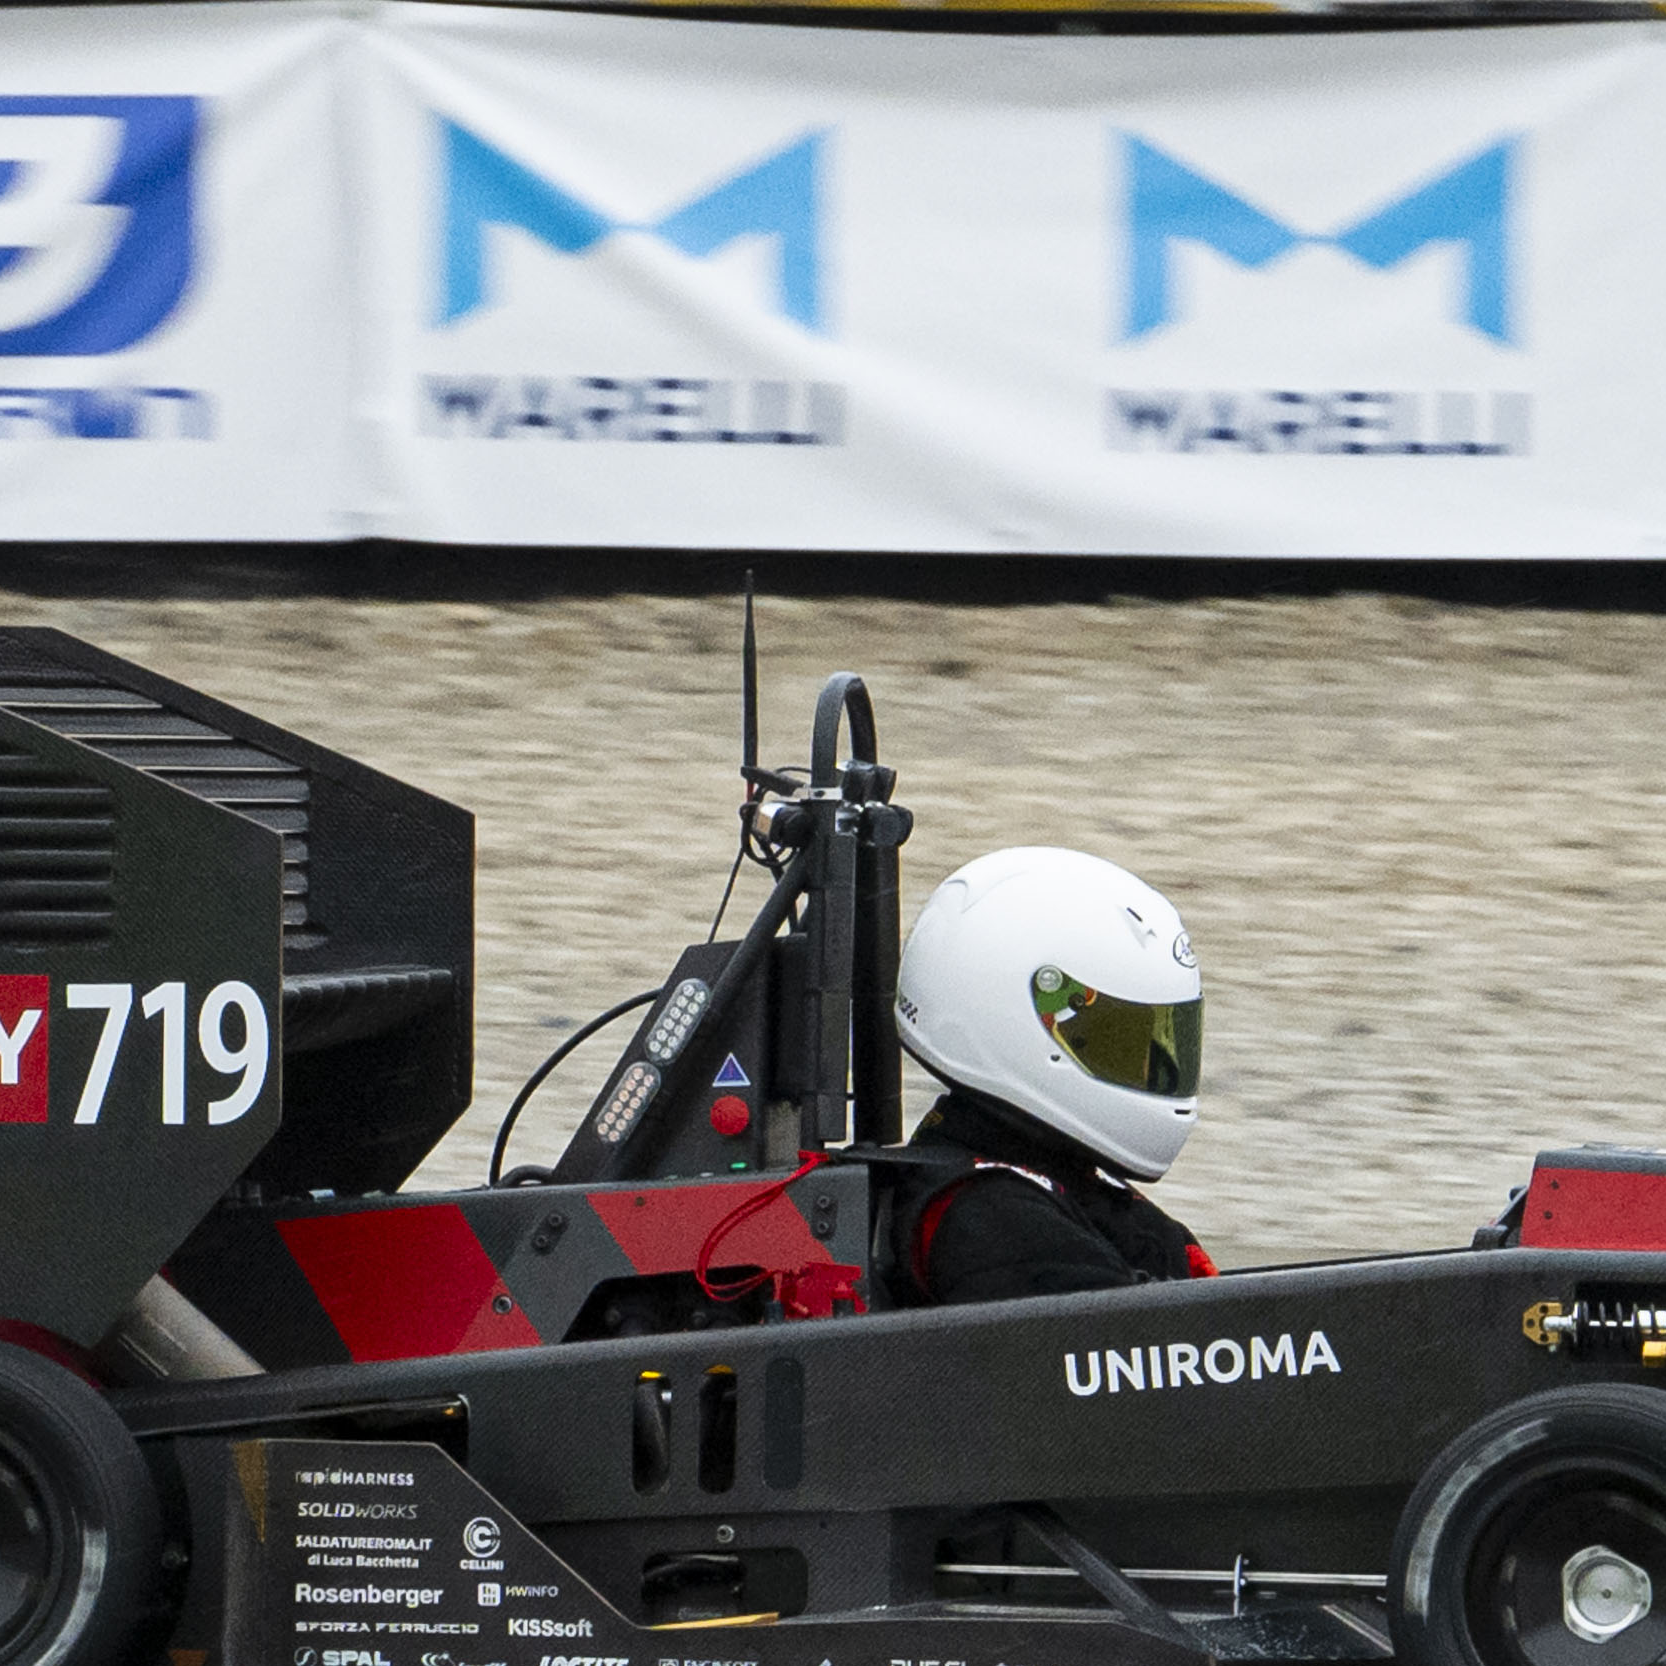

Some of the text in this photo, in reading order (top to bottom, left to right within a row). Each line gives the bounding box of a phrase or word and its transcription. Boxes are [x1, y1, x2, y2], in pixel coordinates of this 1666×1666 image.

[419, 374, 844, 446] MARELLI
[1104, 388, 1531, 456] MARELLI
[65, 980, 270, 1126] 719
[1064, 1330, 1342, 1397] UNIROMA
[297, 1501, 418, 1520] SOLIDWORKS
[295, 1534, 433, 1551] SALDATUREROMA.IT
[307, 1553, 420, 1569] di Luca Bacchetta
[459, 1559, 505, 1571] CELLINI
[295, 1583, 444, 1609] Rosenberger
[295, 1621, 480, 1635] SFORZA FERRUCCIO
[508, 1618, 593, 1638] KISSsoft
[321, 1650, 392, 1666] SPAL
